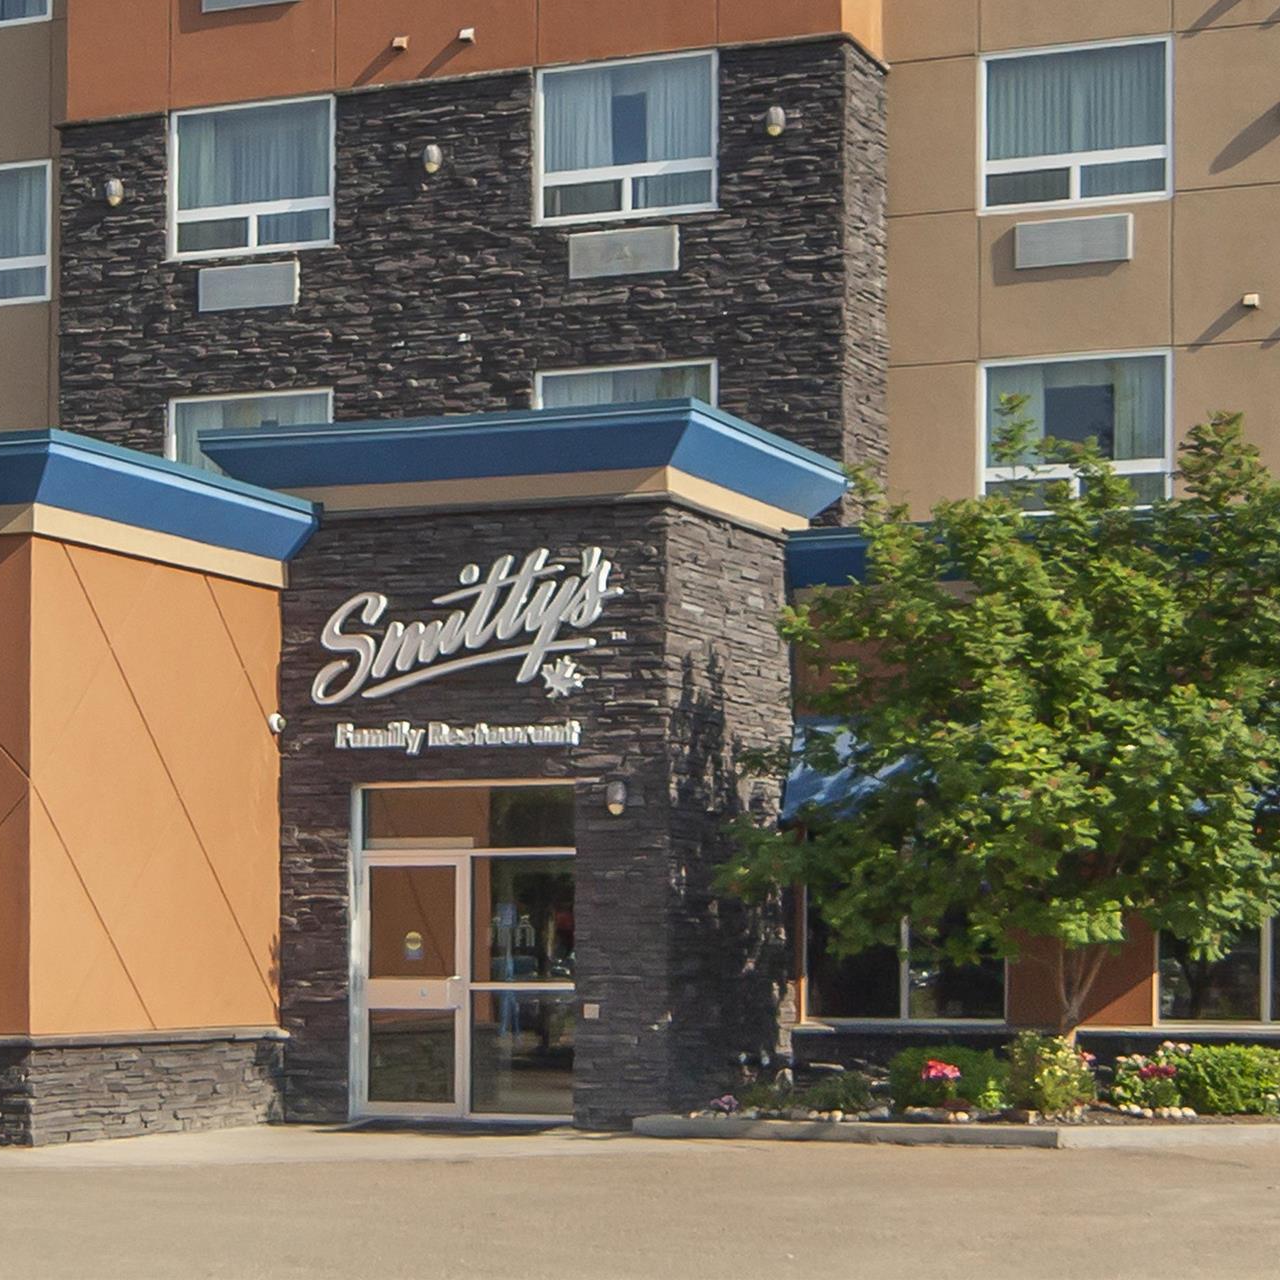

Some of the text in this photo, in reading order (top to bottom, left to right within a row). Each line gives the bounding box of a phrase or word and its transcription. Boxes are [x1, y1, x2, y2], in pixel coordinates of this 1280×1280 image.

[311, 546, 624, 705] Smitty's
[335, 720, 582, 755] Family Restaurant
